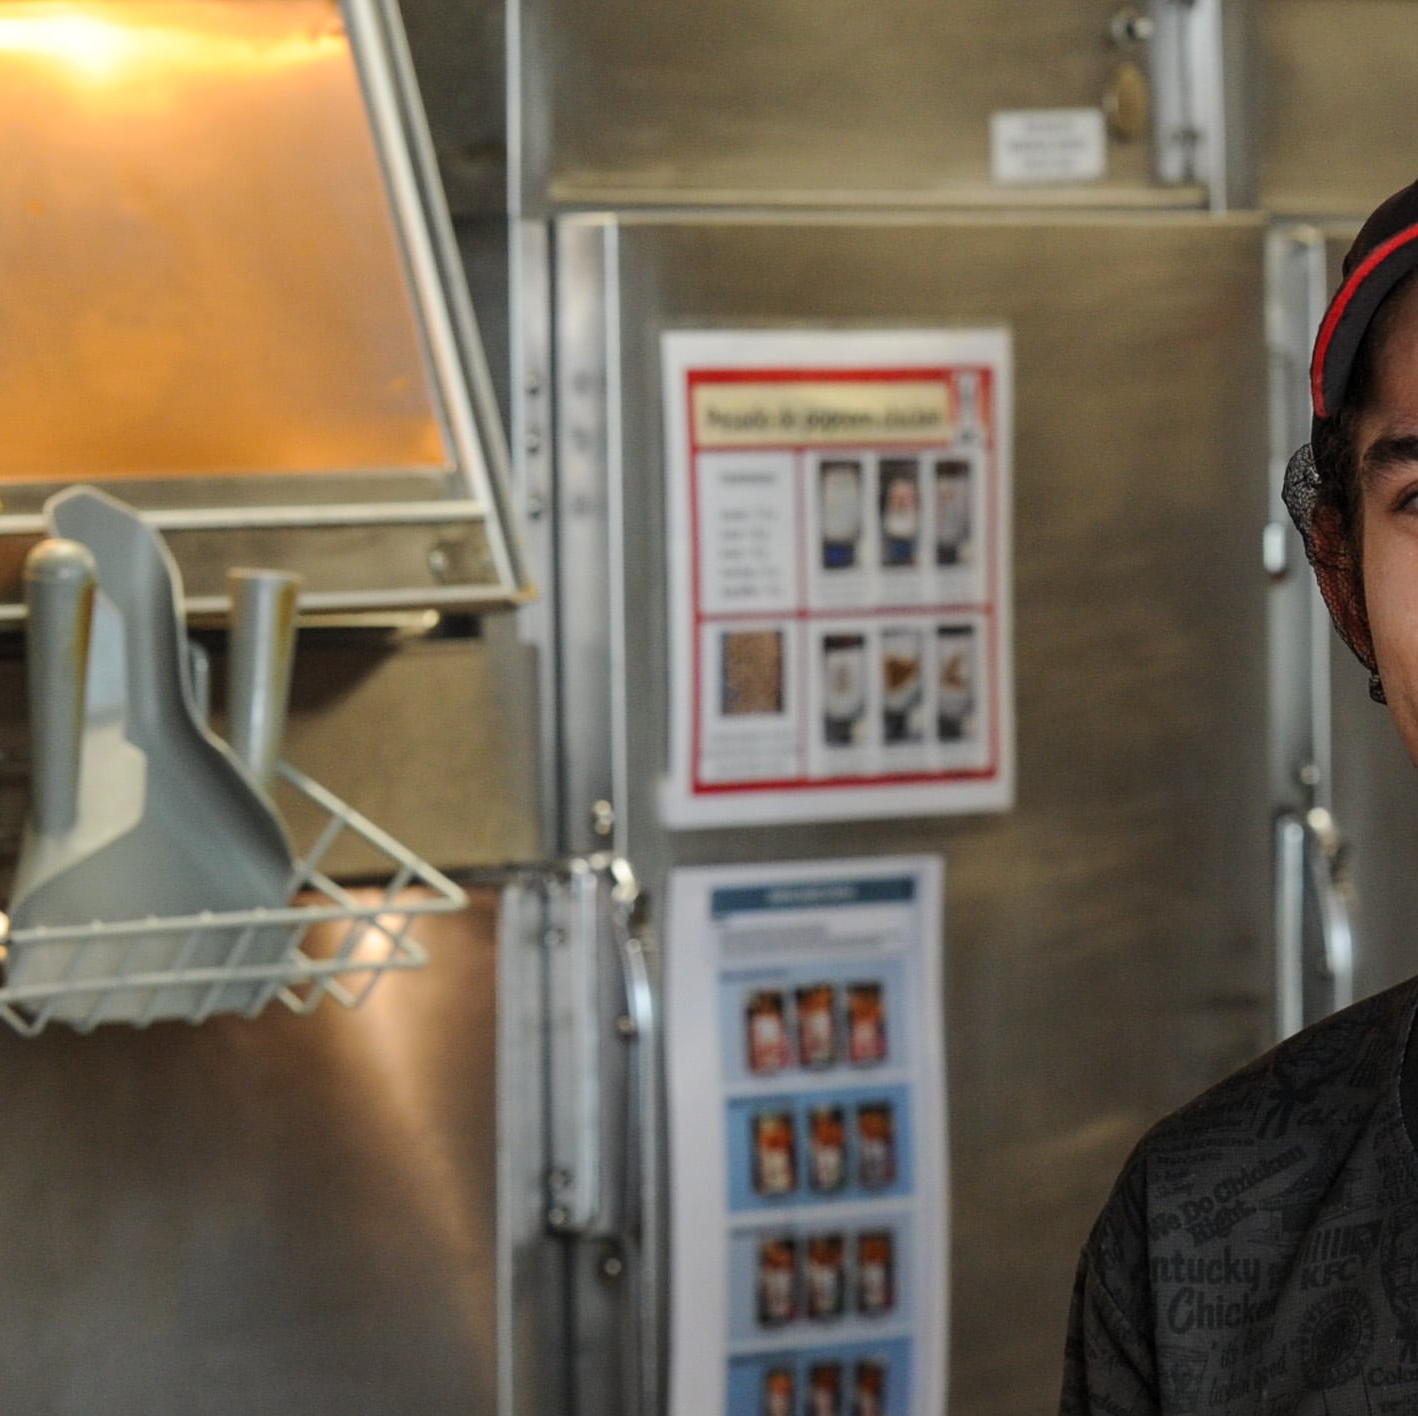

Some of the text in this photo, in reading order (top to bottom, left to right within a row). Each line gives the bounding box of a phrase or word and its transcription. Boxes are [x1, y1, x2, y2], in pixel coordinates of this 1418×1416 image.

[1212, 1145, 1309, 1204] Chicken
[1151, 1246, 1262, 1294] ntucky
[1299, 1254, 1360, 1291] KFC
